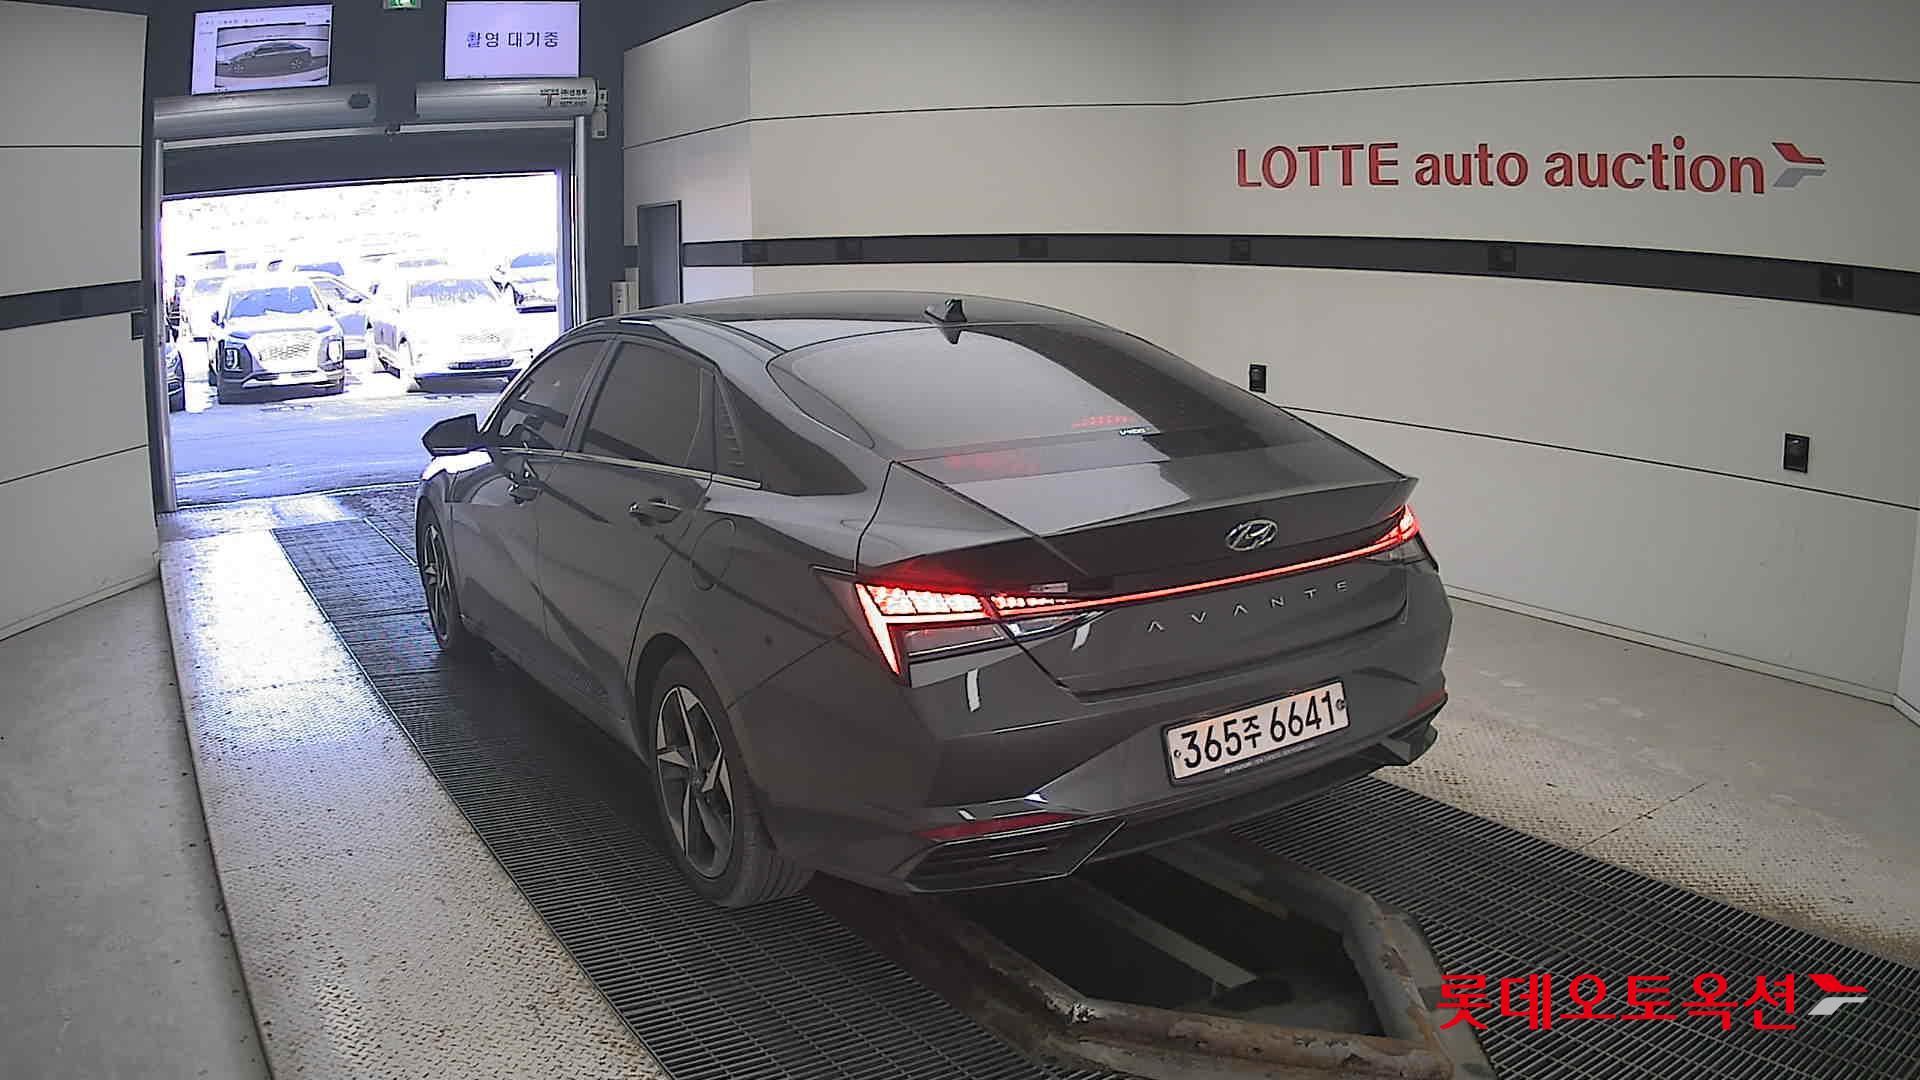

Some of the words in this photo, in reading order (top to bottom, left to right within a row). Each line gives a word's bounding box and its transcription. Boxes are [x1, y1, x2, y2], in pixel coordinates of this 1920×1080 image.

[508, 31, 559, 48] 대기중
[1237, 143, 1399, 188] LOTTE
[1414, 143, 1529, 187] auto
[1545, 135, 1766, 194] auction
[1147, 580, 1349, 633] AVANTE
[1181, 715, 1262, 769] 365주
[1269, 690, 1336, 743] 6641
